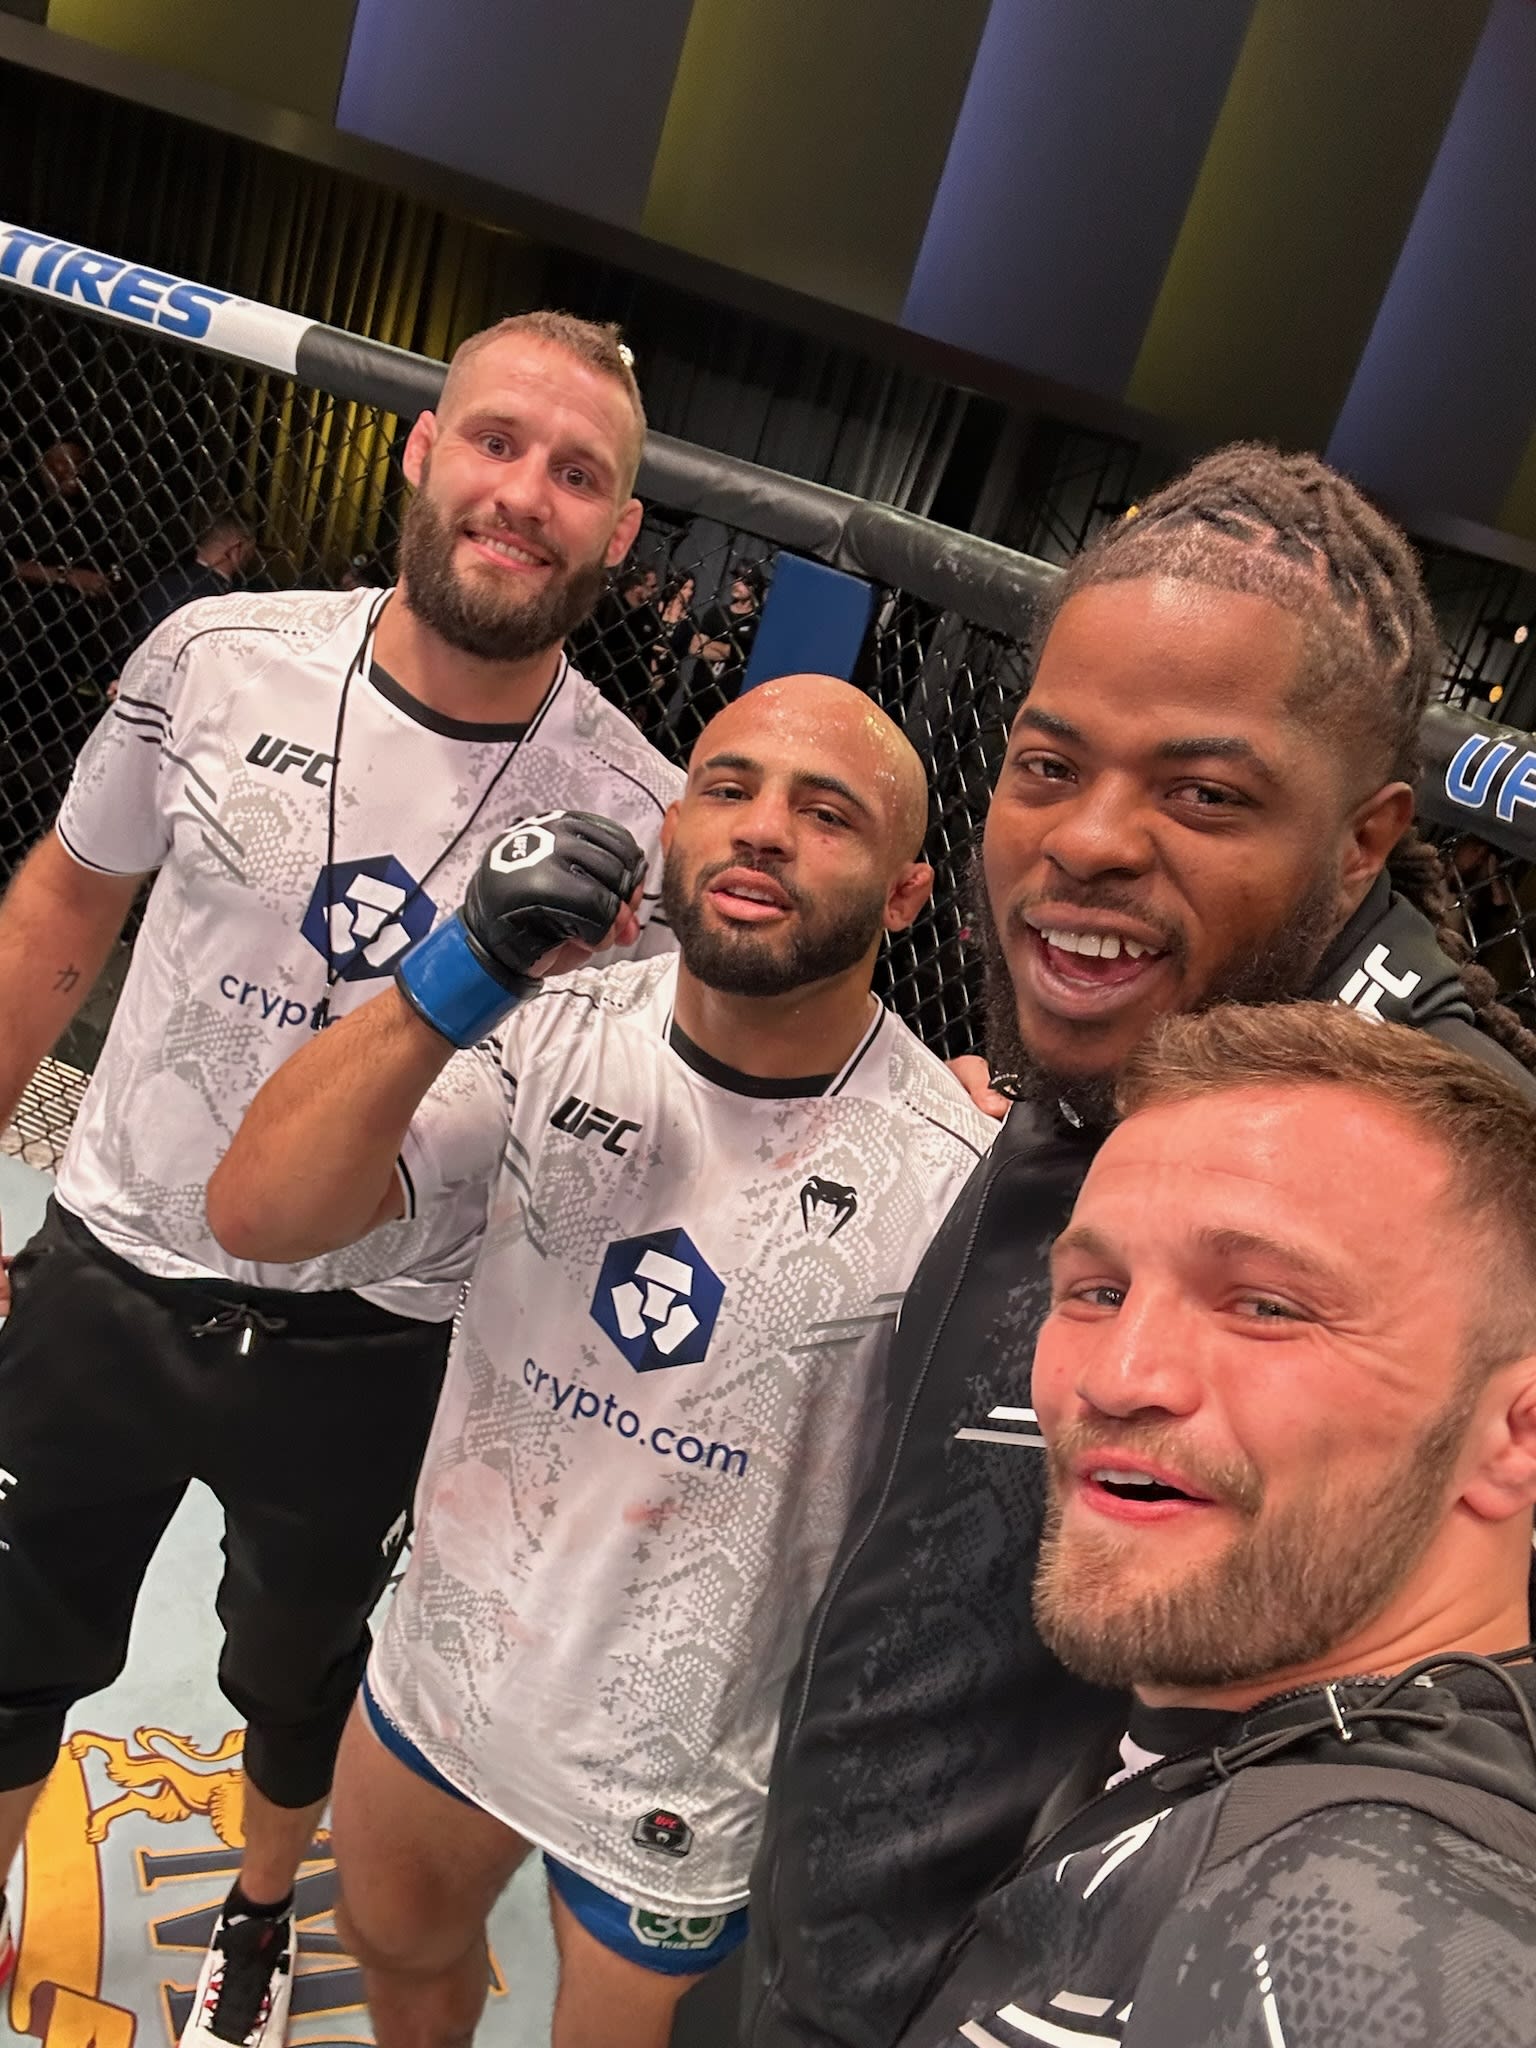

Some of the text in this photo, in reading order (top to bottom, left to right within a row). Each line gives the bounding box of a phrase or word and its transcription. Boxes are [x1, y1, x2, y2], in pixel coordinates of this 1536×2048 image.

[0, 229, 234, 339] TIRES
[246, 733, 339, 788] UFC
[511, 835, 529, 859] UFC
[220, 974, 342, 1030] crypt
[1332, 943, 1422, 1025] FC
[549, 1096, 643, 1157] UFC
[522, 1358, 749, 1477] crypto.com
[654, 1814, 679, 1830] UFC
[643, 1917, 718, 1942] 30
